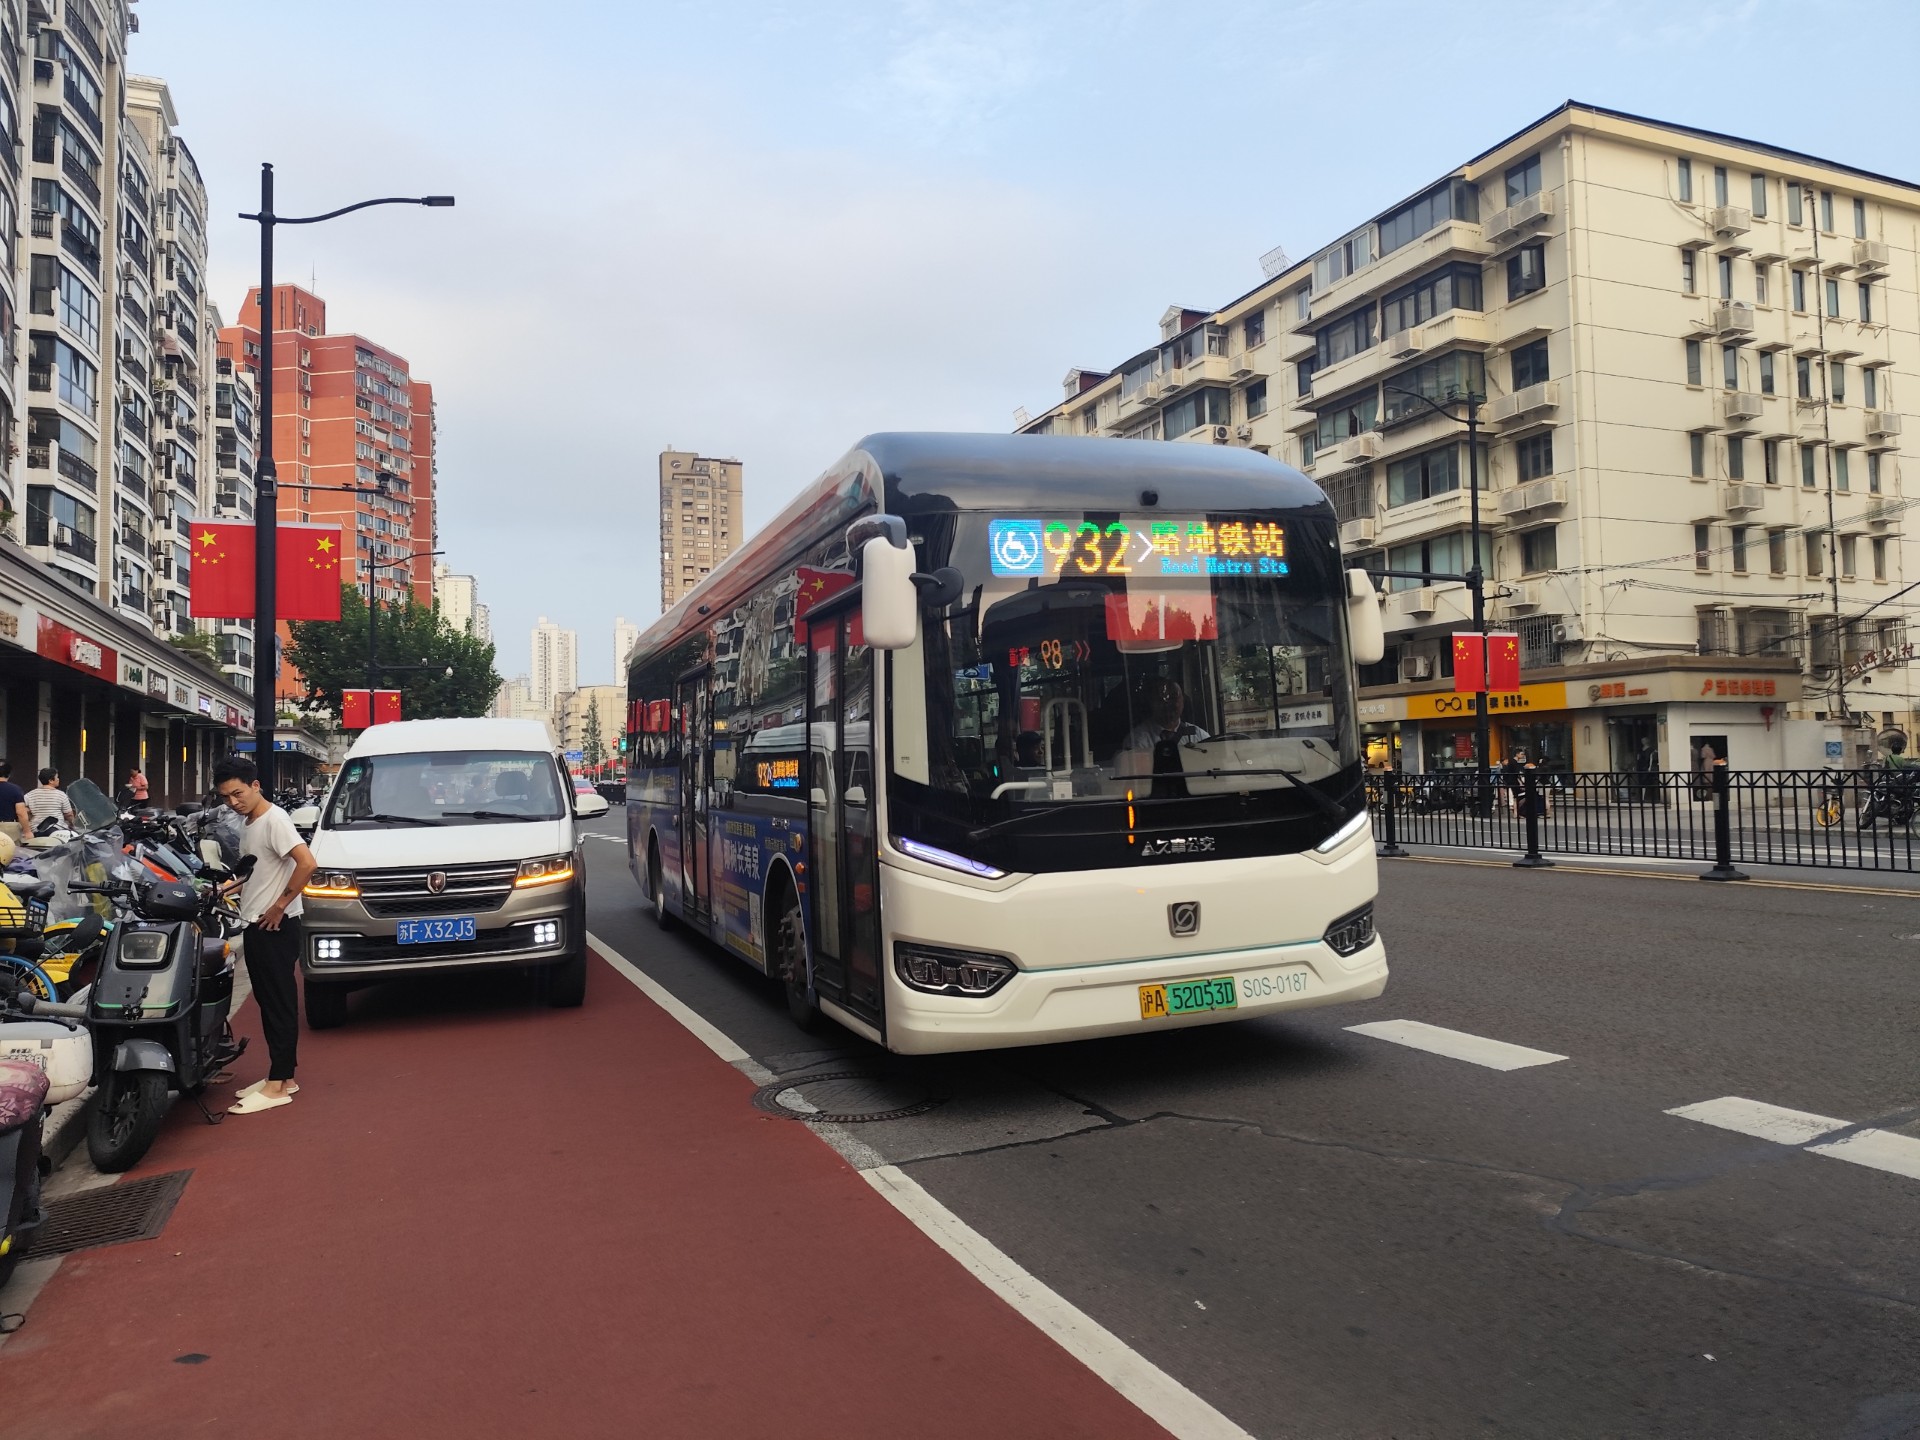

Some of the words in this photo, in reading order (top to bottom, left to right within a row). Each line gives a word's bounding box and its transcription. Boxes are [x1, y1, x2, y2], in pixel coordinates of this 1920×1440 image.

[1043, 521, 1132, 574] 932
[1151, 520, 1284, 557] 路地铁站
[1160, 556, 1199, 574] Road
[1205, 556, 1252, 574] Metro
[1258, 556, 1289, 574] Sta
